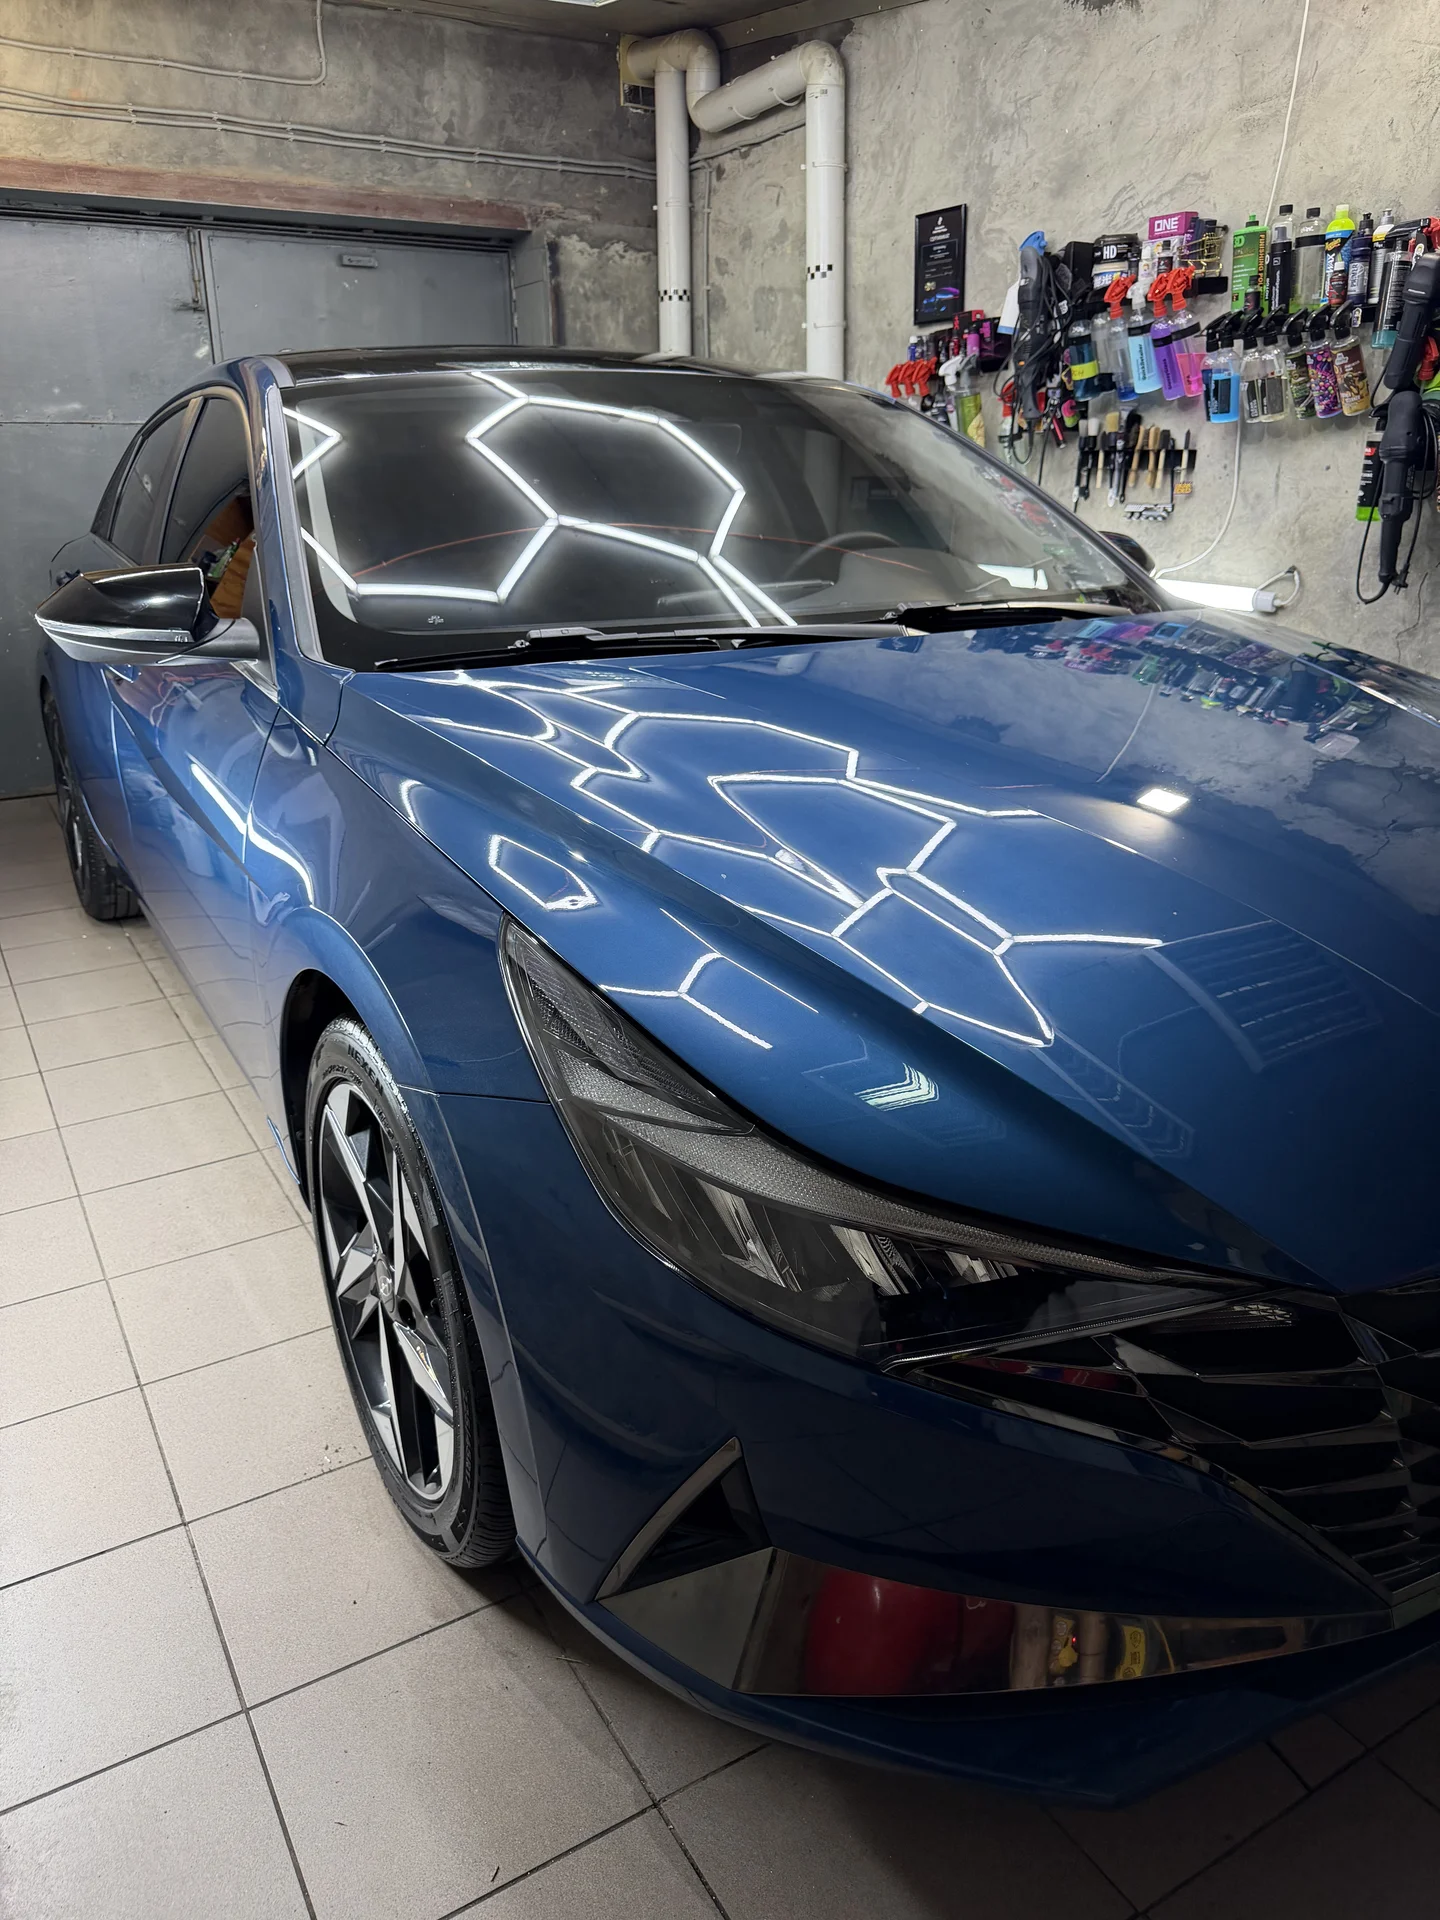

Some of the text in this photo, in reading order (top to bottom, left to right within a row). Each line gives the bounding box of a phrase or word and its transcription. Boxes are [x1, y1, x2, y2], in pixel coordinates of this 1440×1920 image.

[1154, 217, 1179, 232] ONE
[1103, 244, 1118, 259] HD
[1326, 253, 1336, 273] WAX
[348, 1044, 383, 1096] NEXEN
